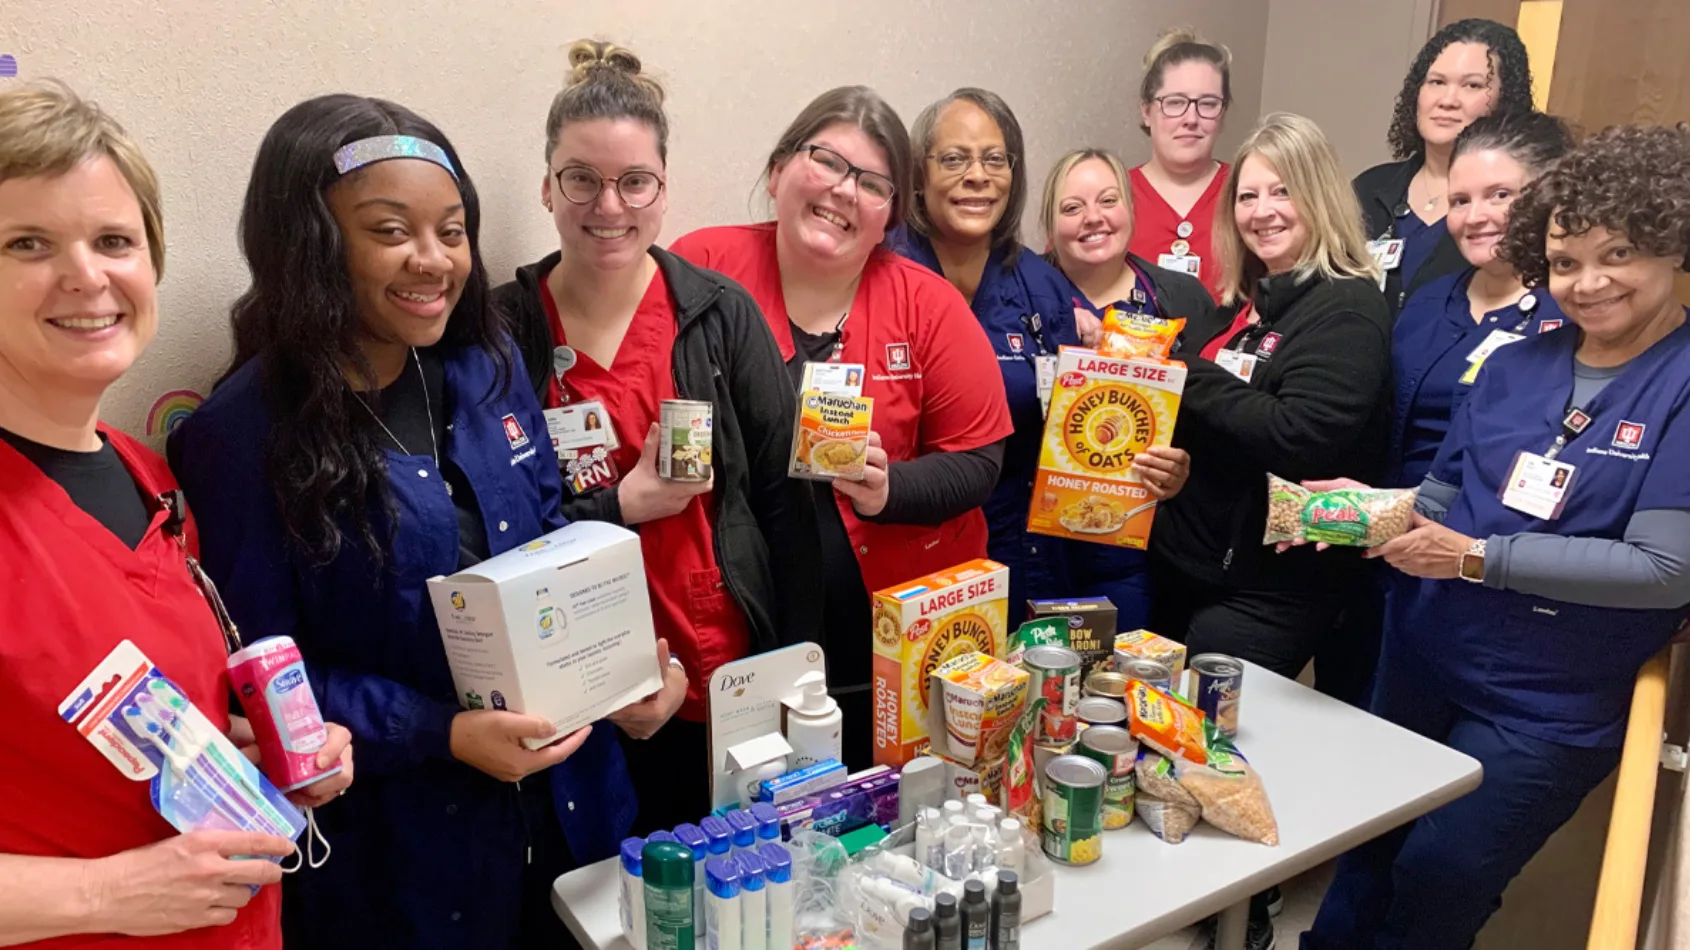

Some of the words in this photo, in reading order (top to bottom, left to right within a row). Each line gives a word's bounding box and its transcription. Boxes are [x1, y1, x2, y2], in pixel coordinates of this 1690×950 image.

[1060, 373, 1084, 388] Post
[1077, 358, 1129, 377] LARGE
[1134, 365, 1168, 382] SIZE
[817, 396, 867, 412] Maruchan
[820, 407, 854, 418] Instant
[1069, 391, 1105, 434] HONEY
[822, 416, 850, 425] Lunch
[1108, 390, 1150, 444] BUNCHES
[817, 425, 850, 437] Chicken
[1075, 442, 1090, 455] of
[1089, 448, 1136, 469] OATS
[578, 461, 612, 490] RN
[1047, 475, 1090, 490] HONEY
[1091, 482, 1148, 499] ROASTED
[1311, 506, 1361, 523] Peak
[920, 592, 965, 616] LARGE
[967, 578, 995, 597] SIZE
[908, 619, 931, 640] Post
[953, 620, 990, 658] BUNCH
[1030, 625, 1057, 645] Pasta
[276, 674, 303, 687] Suave
[720, 672, 755, 691] Dove
[876, 676, 887, 748] ROASTED
[887, 690, 898, 747] HONEY
